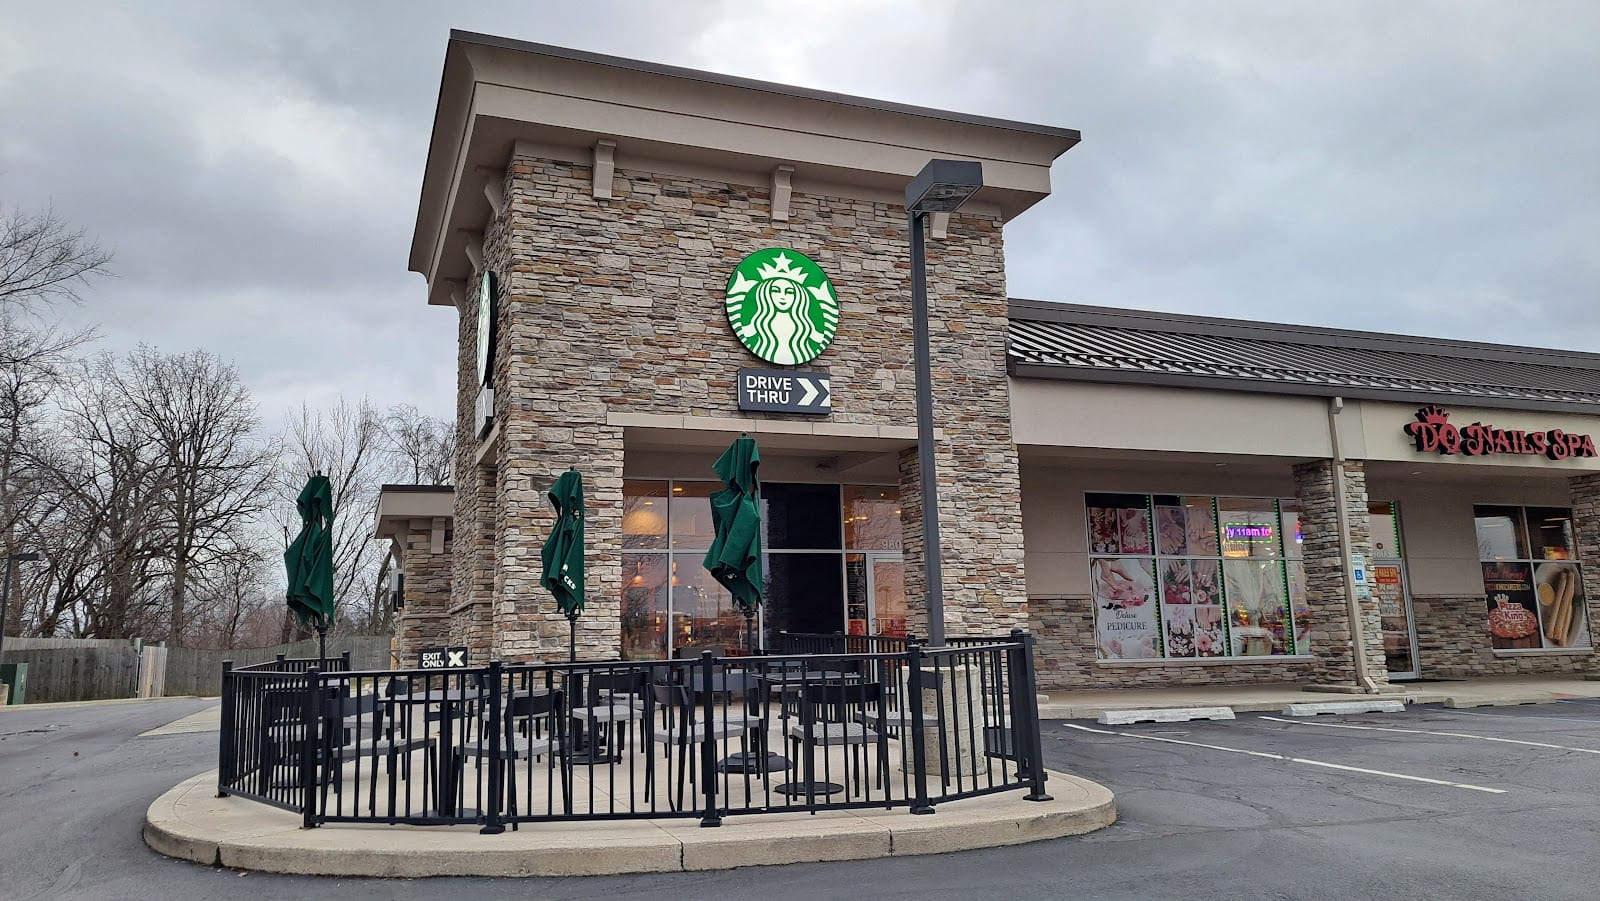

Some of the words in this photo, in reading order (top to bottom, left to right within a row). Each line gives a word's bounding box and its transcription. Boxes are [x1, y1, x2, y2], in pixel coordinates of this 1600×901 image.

[746, 375, 793, 390] DRIVE
[747, 389, 790, 404] THRU
[1463, 423, 1547, 456] NAILS
[1548, 429, 1598, 460] SPA
[1237, 528, 1260, 536] 11am
[1261, 527, 1271, 536] to
[881, 539, 902, 550] 980
[1500, 602, 1522, 610] Pizza
[1505, 610, 1523, 621] King
[1107, 621, 1148, 630] PEDICURE
[422, 652, 442, 660] EXIT
[422, 660, 445, 668] ONLY
